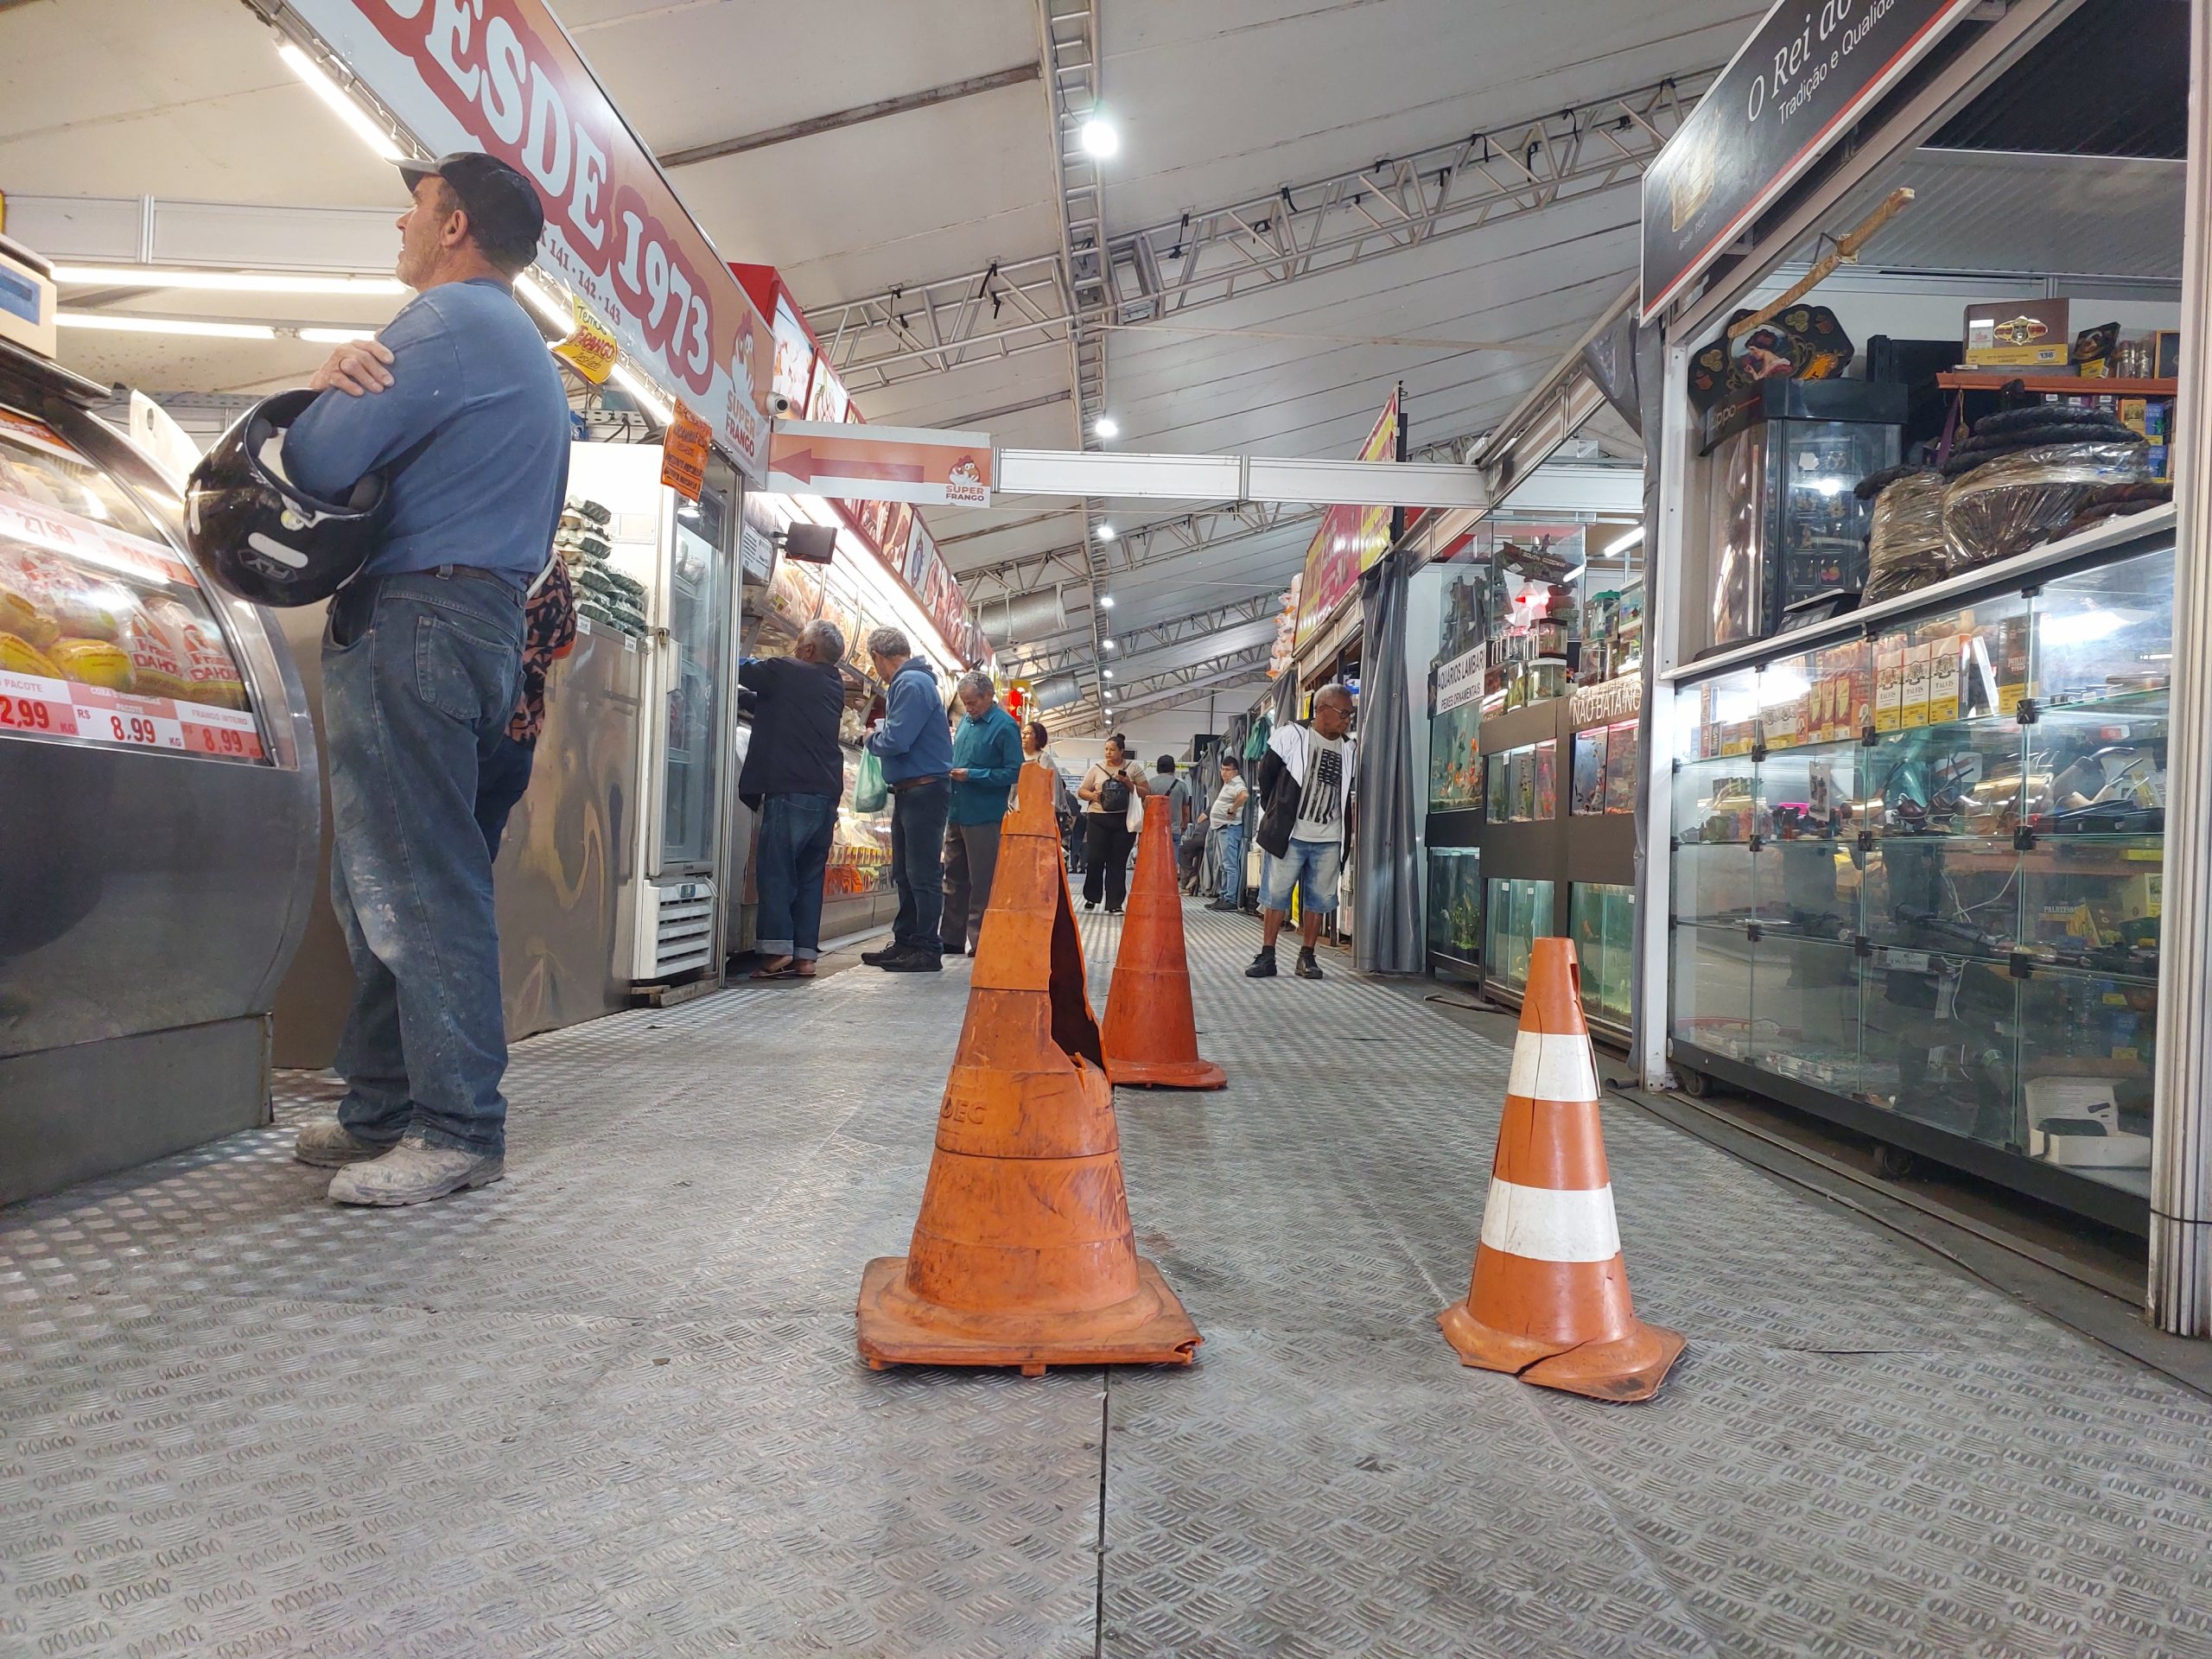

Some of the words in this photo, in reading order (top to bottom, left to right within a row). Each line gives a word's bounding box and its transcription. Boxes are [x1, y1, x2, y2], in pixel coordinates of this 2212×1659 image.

[1748, 74, 1765, 122] O
[1771, 13, 1811, 99] Rei
[1778, 64, 1828, 124] Tradição
[1830, 50, 1840, 70] e
[550, 238, 569, 271] 141
[578, 270, 596, 299] 142
[604, 296, 620, 327] 143
[618, 210, 709, 376] 1973
[727, 390, 756, 440] SUPER
[726, 412, 755, 458] FRANGO
[945, 485, 984, 495] SUPER
[945, 493, 985, 502] FRANGO
[1461, 648, 1485, 680] LAMBARI
[4, 678, 42, 693] PACOTE
[1596, 689, 1623, 720] BATA
[60, 722, 76, 734] KG
[111, 715, 156, 744] 8,99
[168, 736, 181, 747] KG
[203, 728, 243, 753] 8,99
